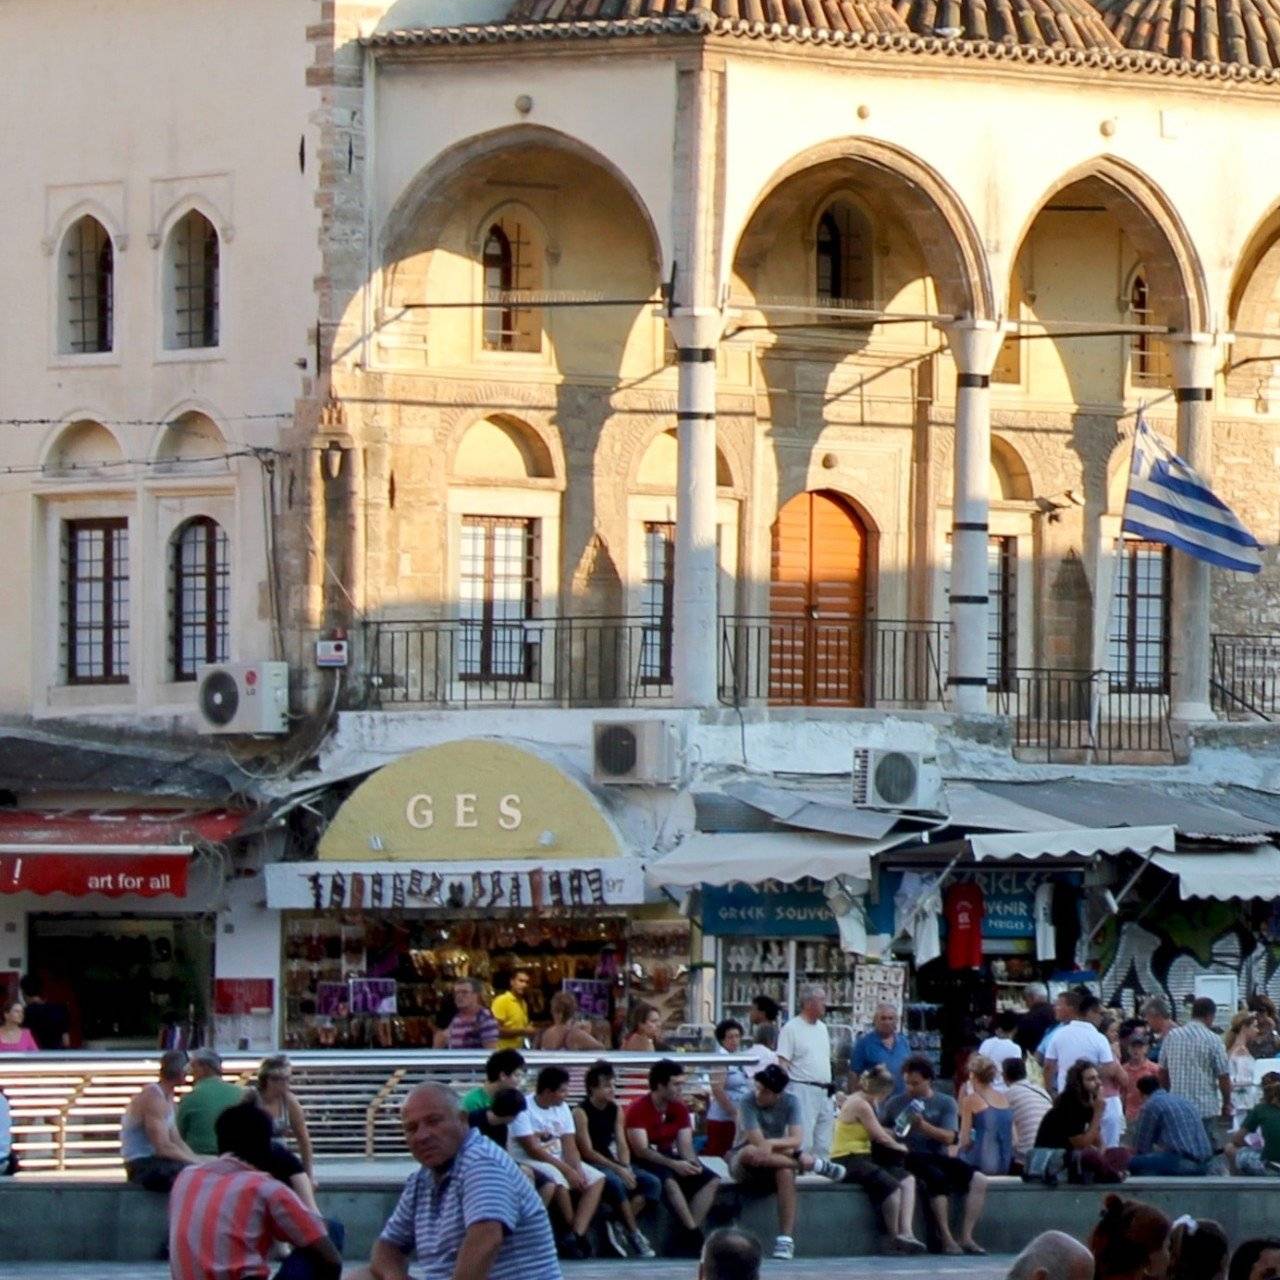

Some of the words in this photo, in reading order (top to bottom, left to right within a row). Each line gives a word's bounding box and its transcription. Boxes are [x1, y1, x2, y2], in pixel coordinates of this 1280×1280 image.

[406, 794, 522, 830] GES
[88, 875, 113, 889] art
[118, 873, 144, 889] for
[150, 874, 170, 889] all
[718, 906, 766, 920] GREEK
